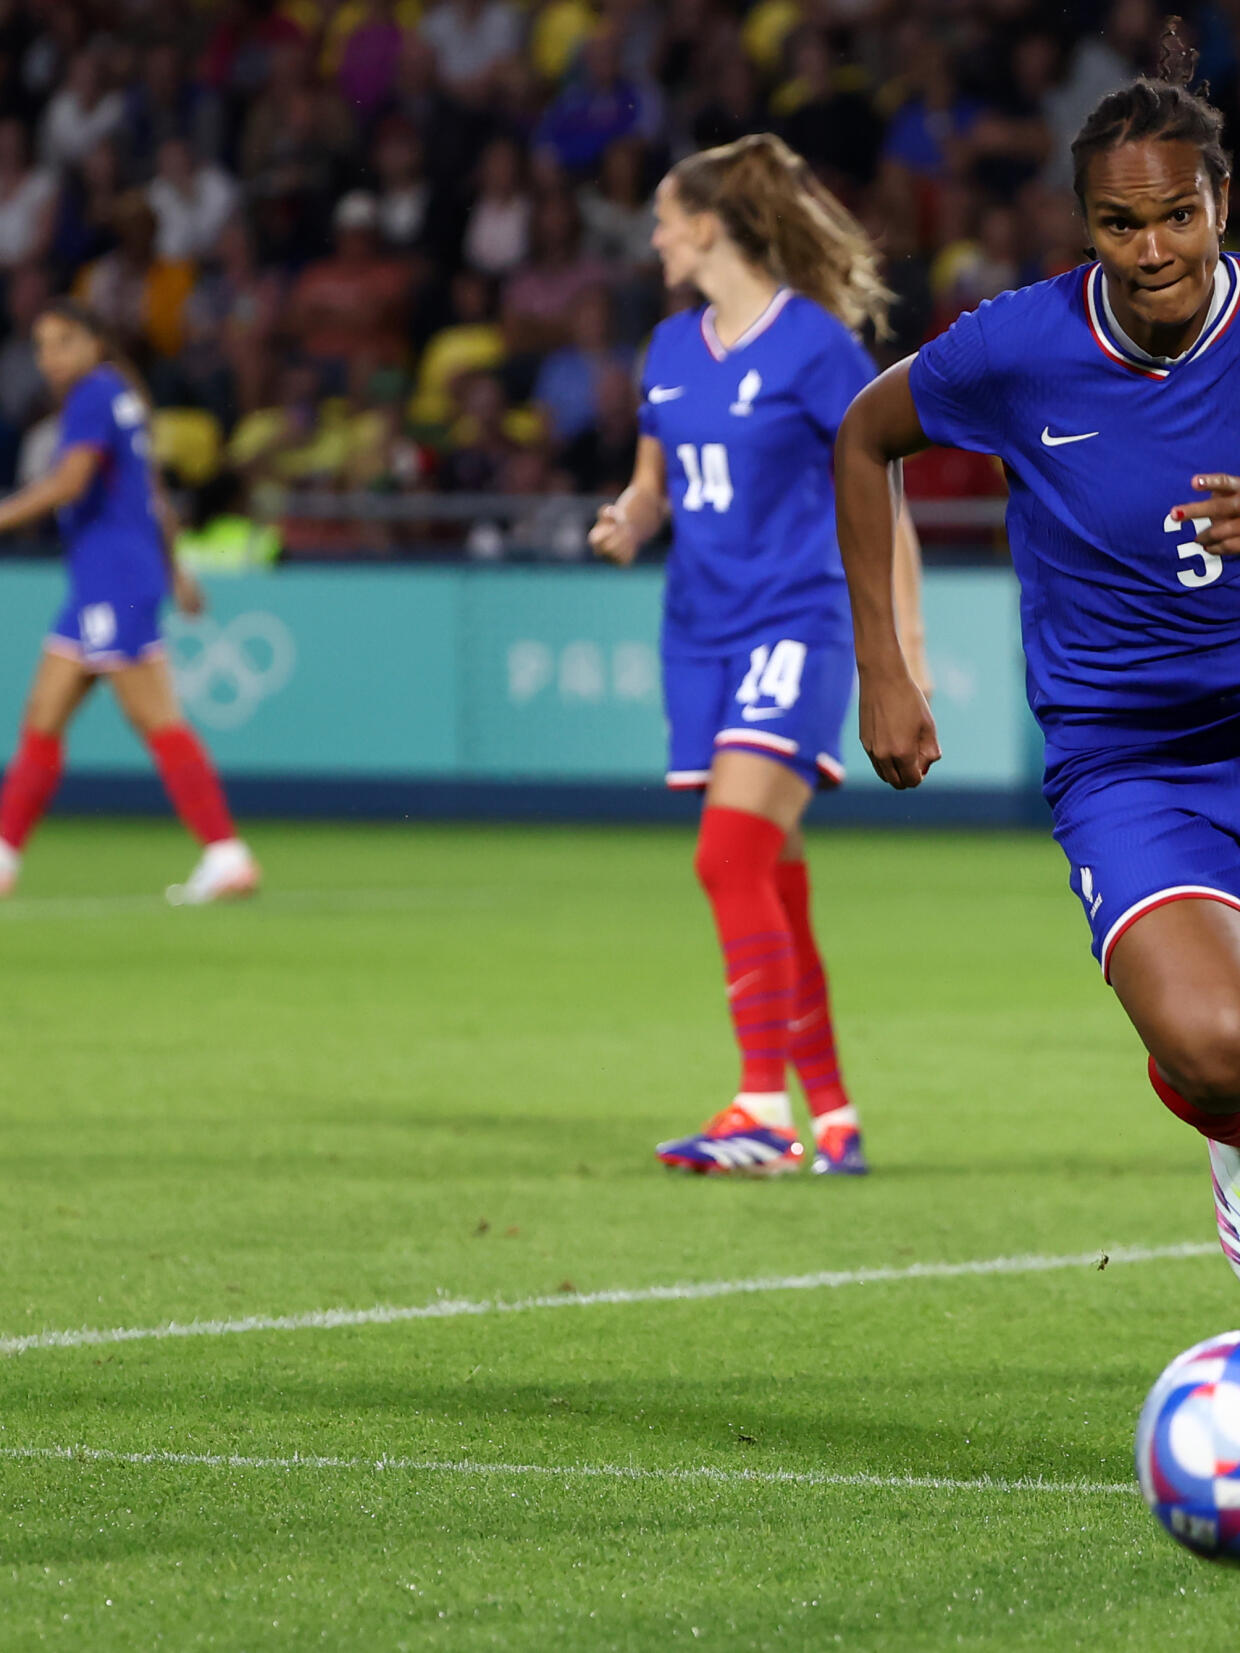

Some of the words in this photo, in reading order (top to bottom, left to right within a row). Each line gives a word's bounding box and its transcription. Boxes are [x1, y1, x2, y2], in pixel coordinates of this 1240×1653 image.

[676, 443, 733, 513] 14
[1164, 513, 1223, 588] 3
[735, 638, 807, 709] 14
